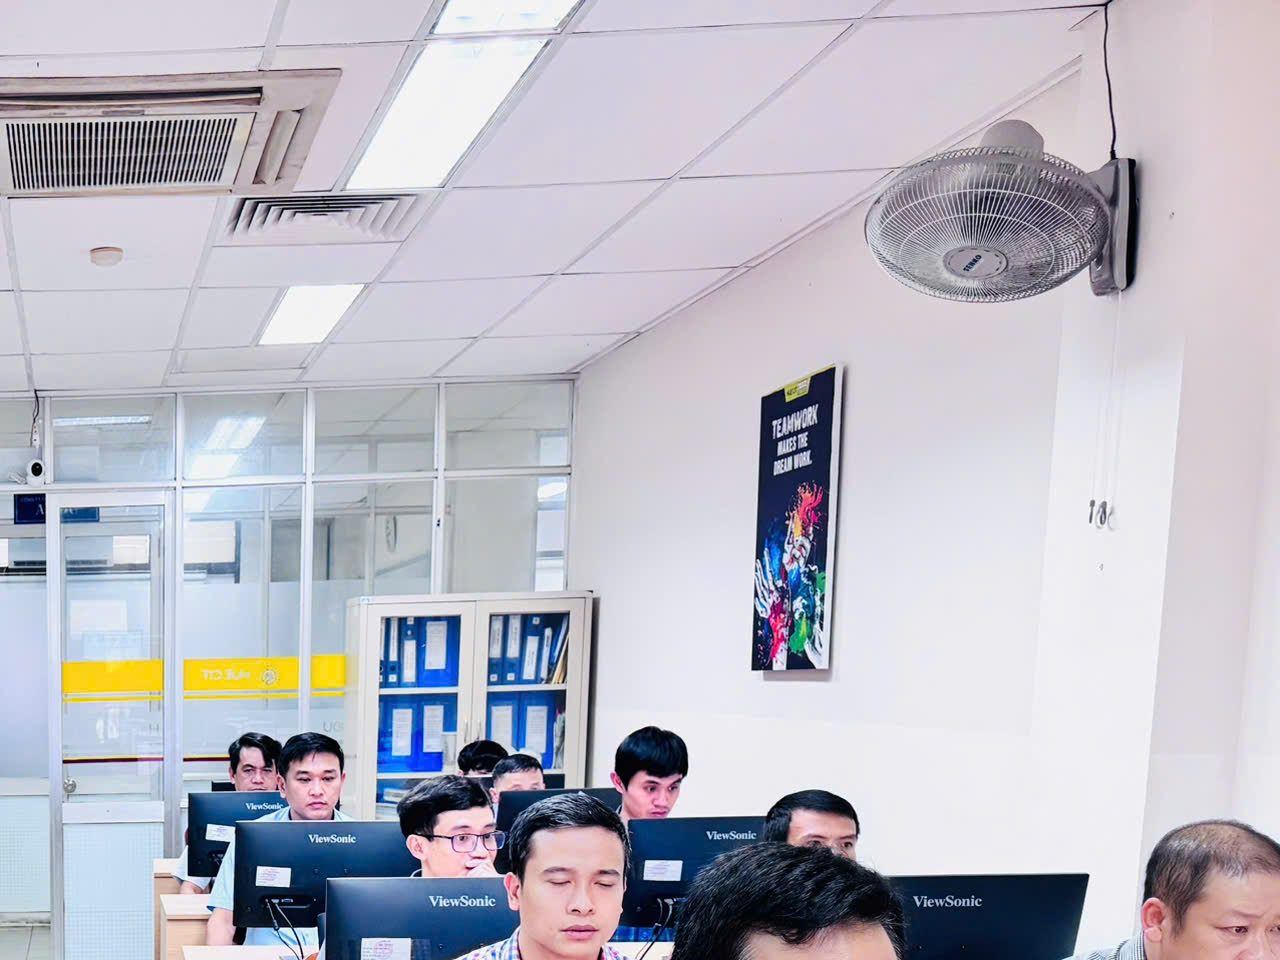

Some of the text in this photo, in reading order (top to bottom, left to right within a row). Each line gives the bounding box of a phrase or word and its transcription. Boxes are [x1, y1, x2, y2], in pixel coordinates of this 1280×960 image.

[772, 404, 819, 439] TEAMWORK
[777, 432, 808, 456] MAKES THE
[773, 456, 793, 476] DREAM
[245, 802, 283, 811] ViewSonic
[308, 833, 357, 844] ViewSonic
[706, 830, 757, 840] ViewSonic
[428, 895, 496, 907] ViewSonic
[913, 895, 983, 908] ViewSonic
